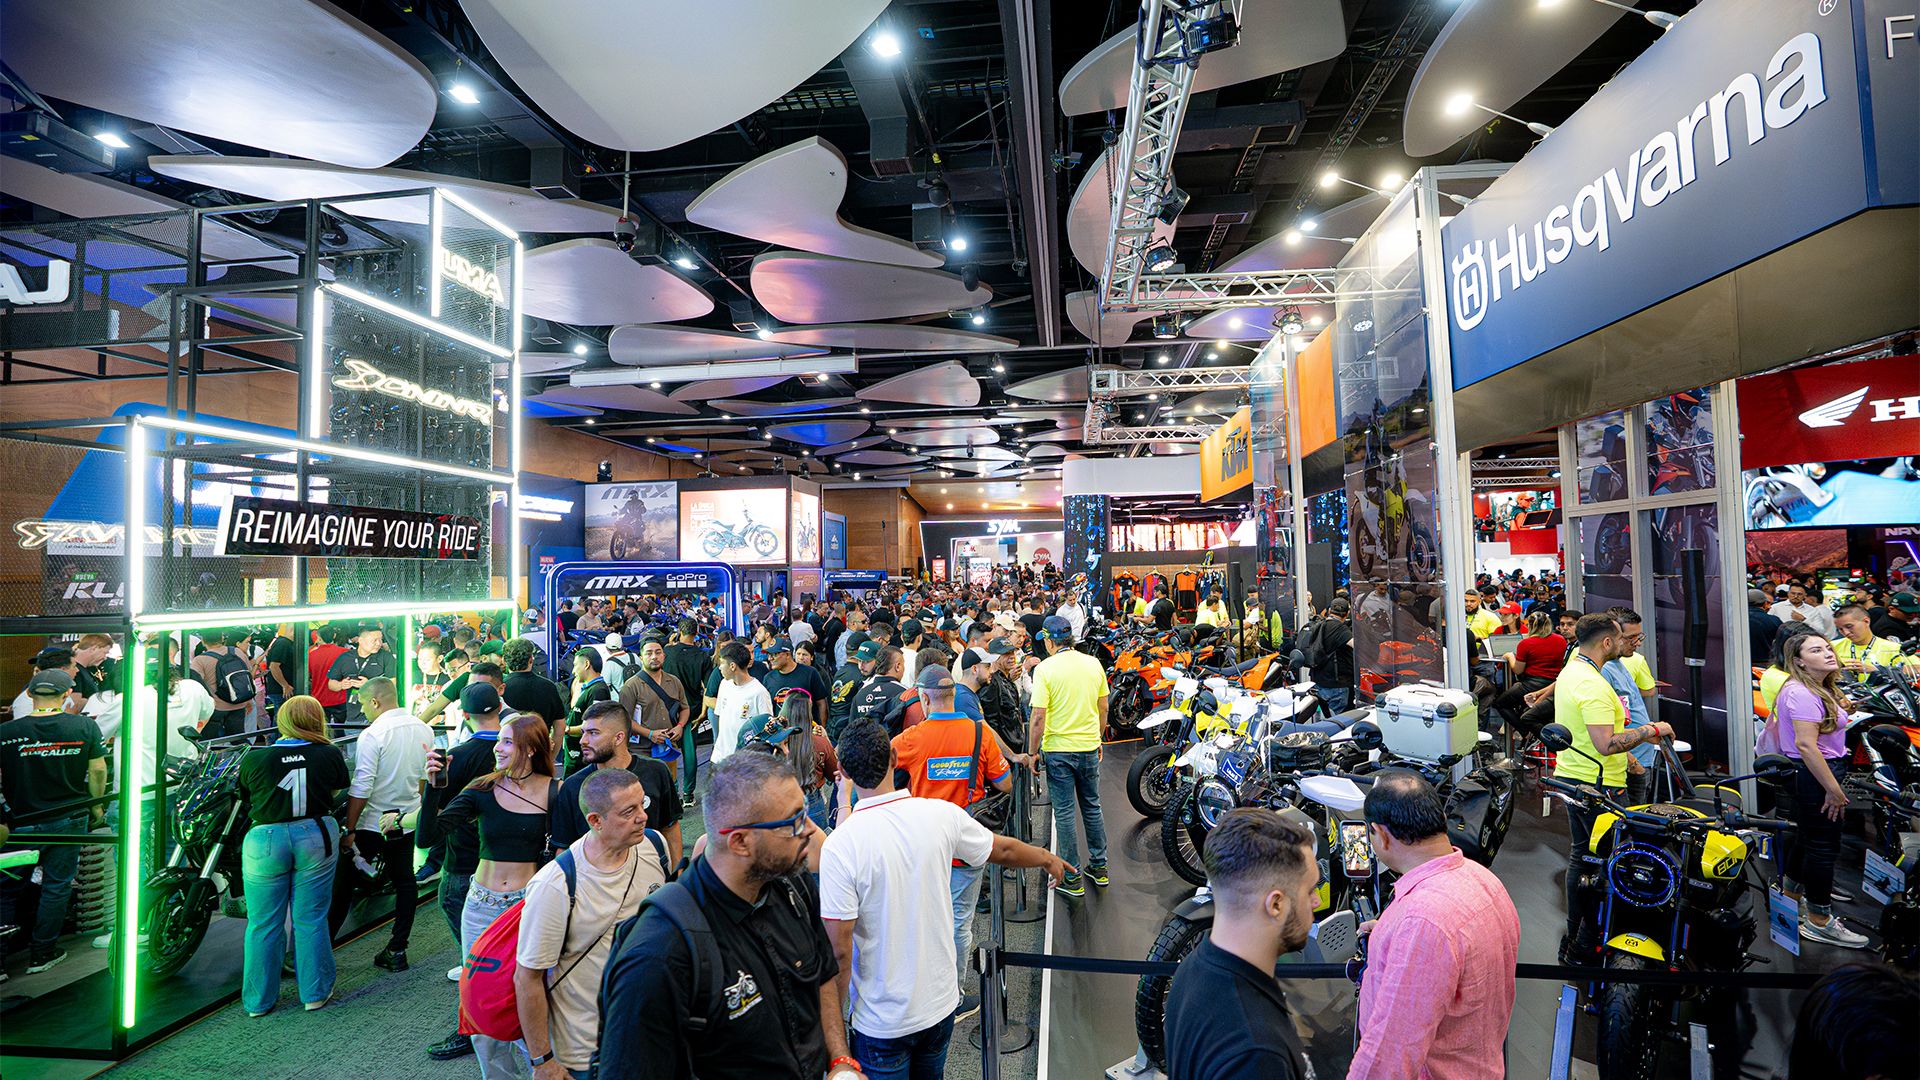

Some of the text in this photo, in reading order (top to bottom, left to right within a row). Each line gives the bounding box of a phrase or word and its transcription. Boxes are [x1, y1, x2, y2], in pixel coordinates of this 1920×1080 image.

[1489, 32, 1828, 302] Husqvarna
[1221, 427, 1249, 482] KTM
[602, 485, 675, 500] MRX
[231, 509, 478, 551] REIMAGINE YOUR RIDE
[987, 519, 1021, 536] SYM
[1034, 552, 1050, 562] SYM
[584, 575, 655, 590] MRX
[666, 573, 708, 581] GoPro
[41, 747, 81, 757] CALLES
[281, 755, 306, 764] UMA
[930, 760, 970, 770] GOODYEAR
[277, 768, 307, 817] 1
